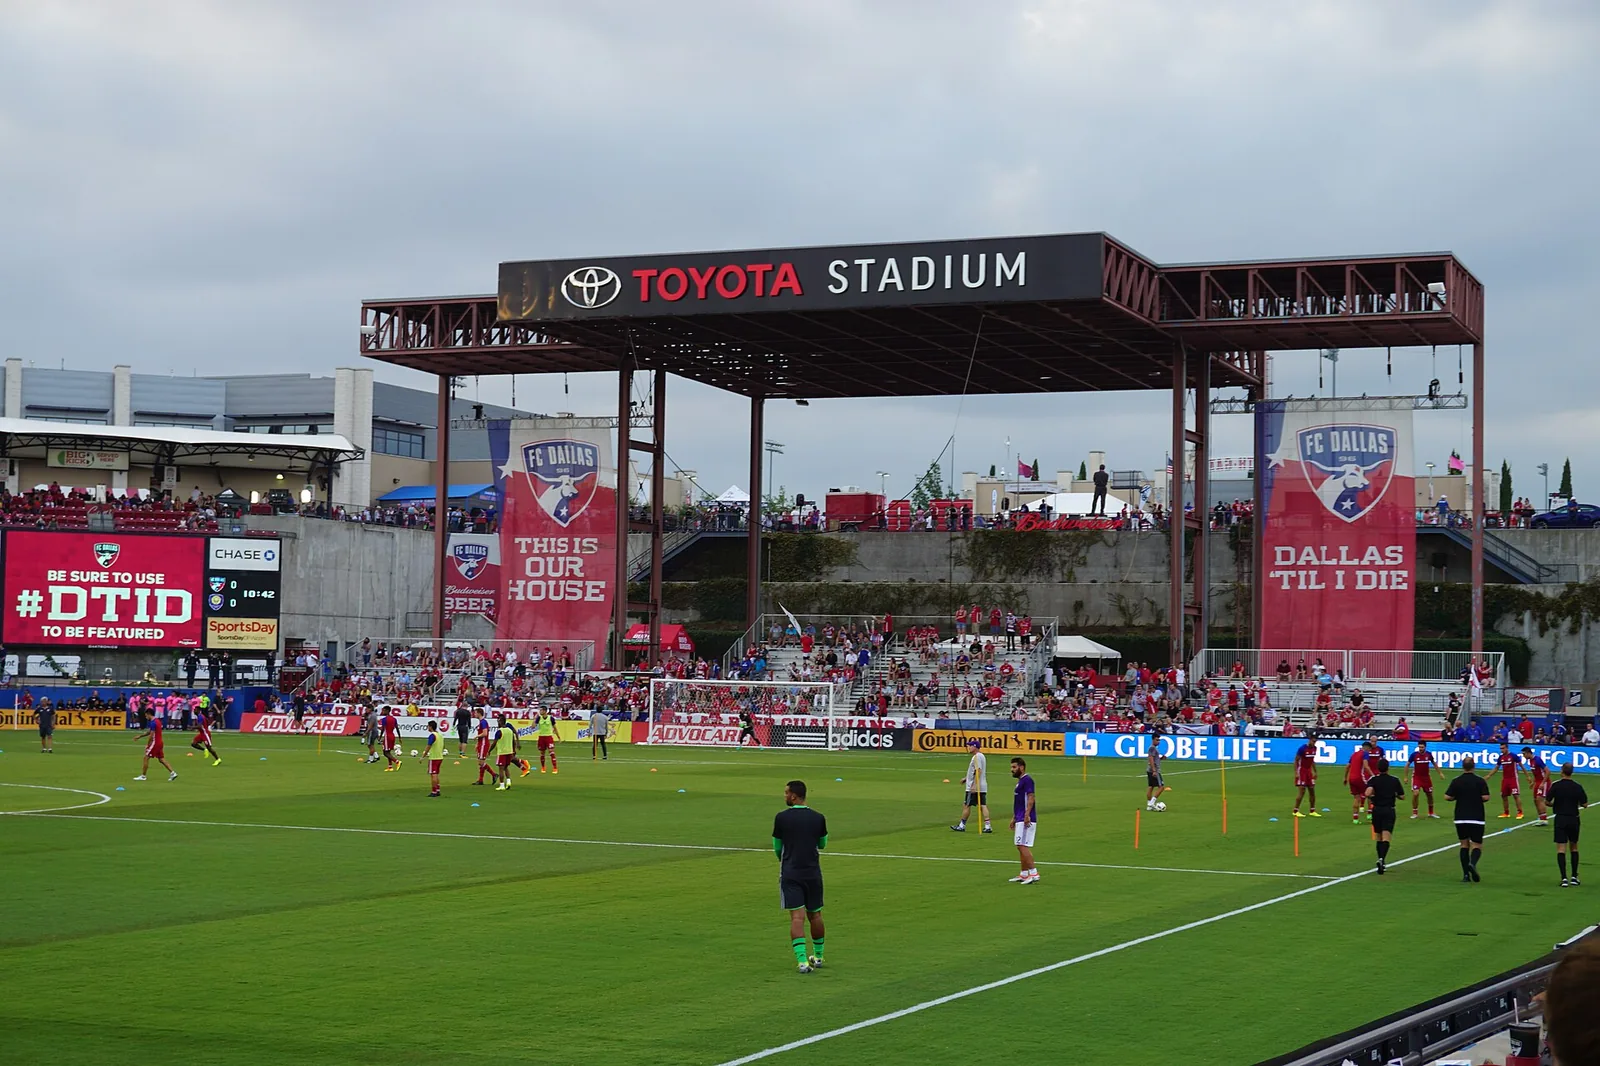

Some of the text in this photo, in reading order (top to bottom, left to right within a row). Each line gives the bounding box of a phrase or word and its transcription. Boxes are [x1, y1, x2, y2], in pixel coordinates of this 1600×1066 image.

[632, 251, 1027, 302] TOYOTA STADIUM
[1305, 431, 1388, 456] FC DALLAS
[66, 450, 86, 458] BIG
[528, 444, 594, 468] FC DALLAS
[455, 545, 487, 556] FC DALLAS
[515, 537, 598, 554] THIS IS
[215, 549, 261, 560] CHASE
[1274, 545, 1403, 566] DALLAS
[525, 556, 585, 577] OUR
[47, 570, 165, 585] BE SURE TO USE
[230, 580, 237, 589] 0
[1335, 570, 1345, 590] I
[1355, 570, 1408, 590] DIE
[243, 590, 275, 599] 10:42
[445, 584, 495, 595] Budweiser
[508, 579, 606, 602] HOUSE
[16, 585, 193, 624] #DTID
[230, 599, 236, 607] 0
[41, 625, 165, 639] TO BE FEATURED
[209, 620, 276, 635] SportsDay
[88, 715, 122, 726] TIRE
[831, 730, 893, 748] adidas
[1026, 738, 1062, 751] TIRE
[1114, 735, 1271, 761] GLOBE LIFE
[1540, 750, 1565, 768] FC
